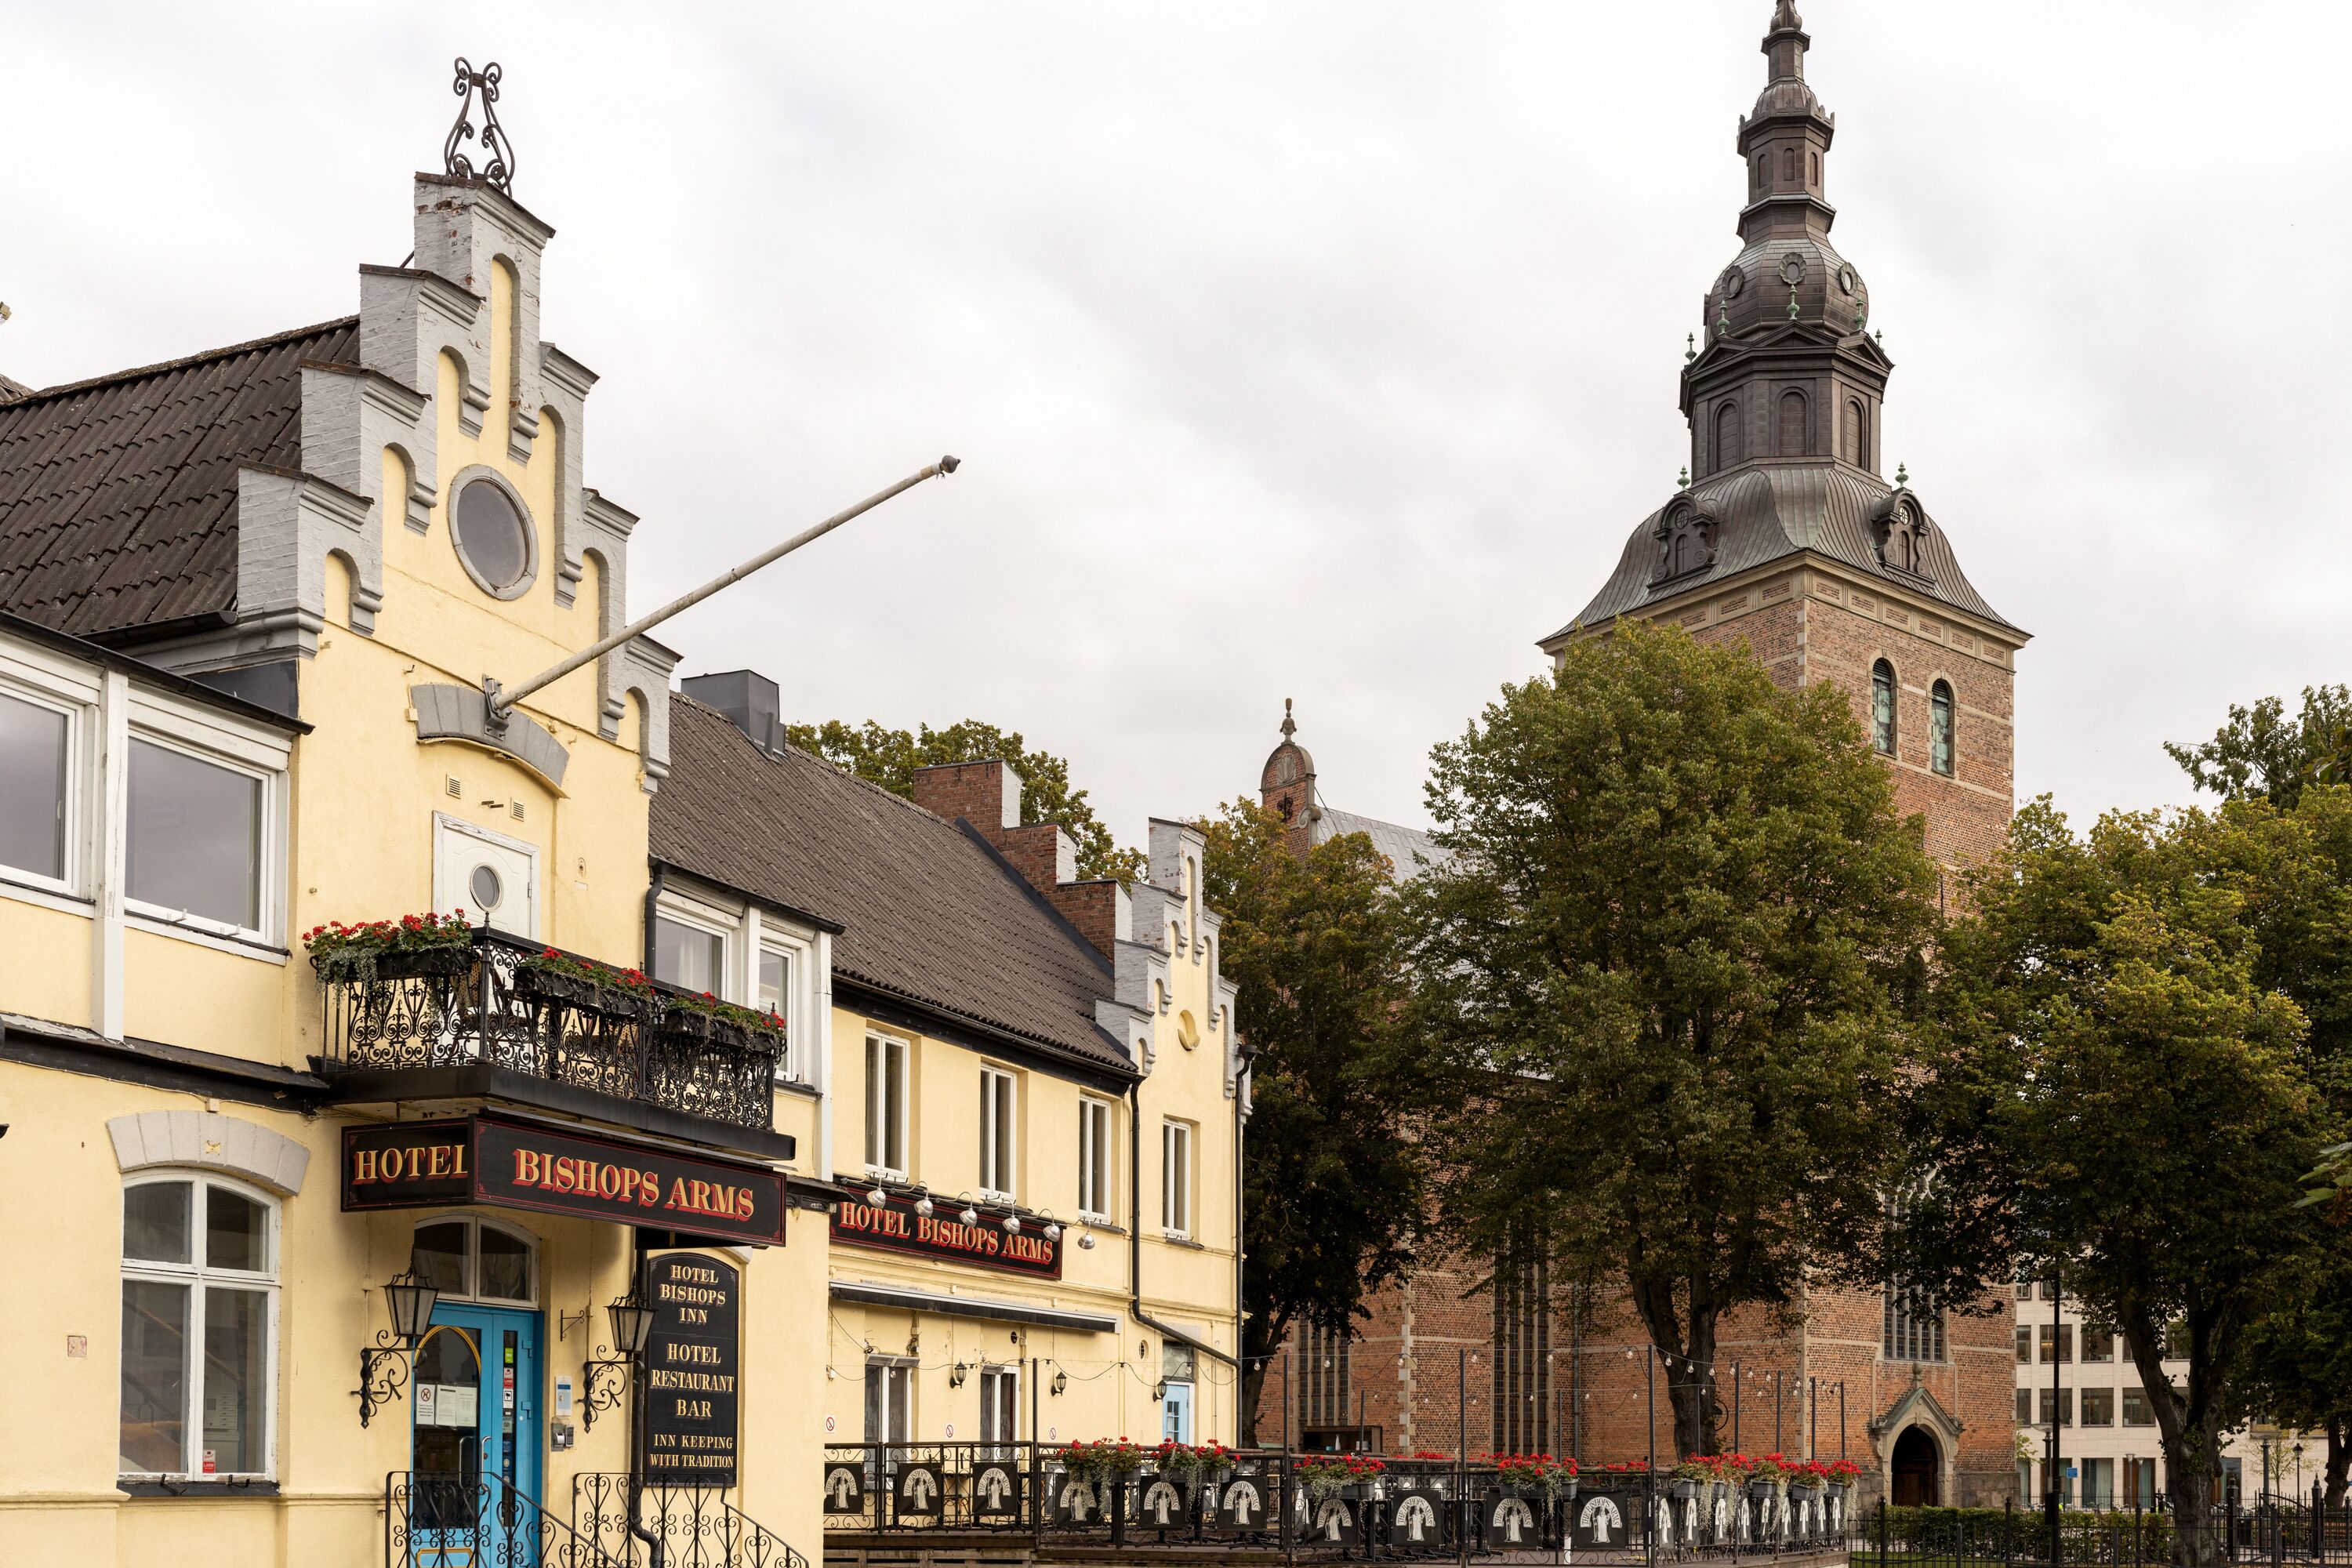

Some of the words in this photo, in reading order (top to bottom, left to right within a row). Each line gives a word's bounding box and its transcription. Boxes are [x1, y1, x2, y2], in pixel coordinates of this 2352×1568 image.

[353, 1145, 468, 1185] HOTEL
[513, 1148, 659, 1207] BISHOPS
[664, 1177, 755, 1221] ARMS
[839, 1200, 911, 1237] HOTEL
[916, 1215, 999, 1254] BISHOPS
[1000, 1233, 1054, 1265] ARMS
[670, 1265, 719, 1283] HOTEL
[659, 1283, 726, 1306] BISHOPS
[679, 1307, 708, 1323] INN
[667, 1343, 721, 1365] HOTEL
[651, 1370, 734, 1392] RESTAURANT
[676, 1399, 713, 1417] BAR
[654, 1434, 676, 1447] INN
[681, 1435, 733, 1450] KEEPING
[649, 1454, 679, 1468] WITH
[682, 1454, 734, 1468] TRADITION
[1424, 1506, 1433, 1524] ARMS
[1522, 1506, 1531, 1525] ARMS
[1610, 1507, 1620, 1526] ARMS
